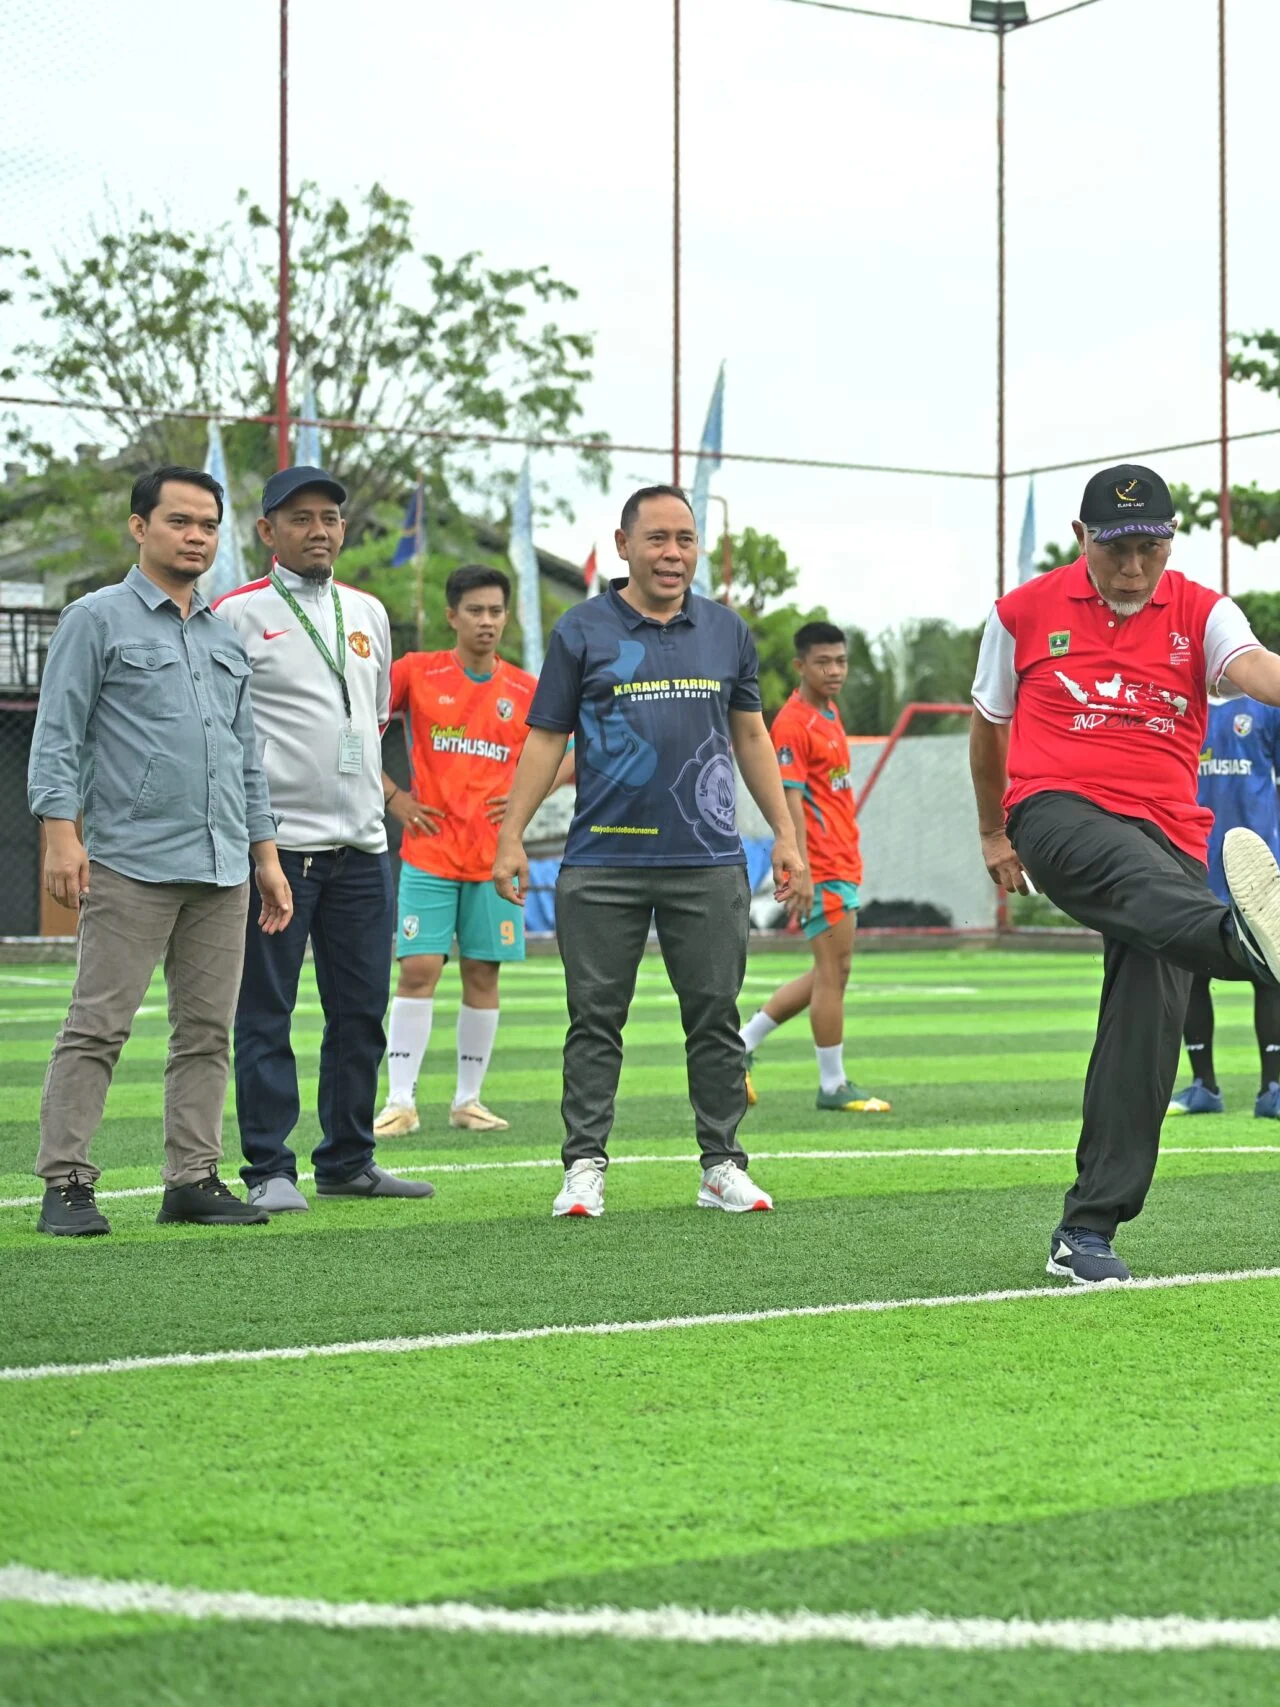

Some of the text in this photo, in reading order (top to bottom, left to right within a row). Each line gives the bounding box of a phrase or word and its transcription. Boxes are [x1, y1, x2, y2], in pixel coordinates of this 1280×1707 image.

[1169, 631, 1190, 650] 79
[613, 678, 721, 697] KARANG TARUNA
[631, 690, 682, 702] Sumatera
[432, 735, 511, 763] ENTHUSIAST
[1198, 758, 1253, 776] THUSIAST
[500, 920, 515, 945] 9
